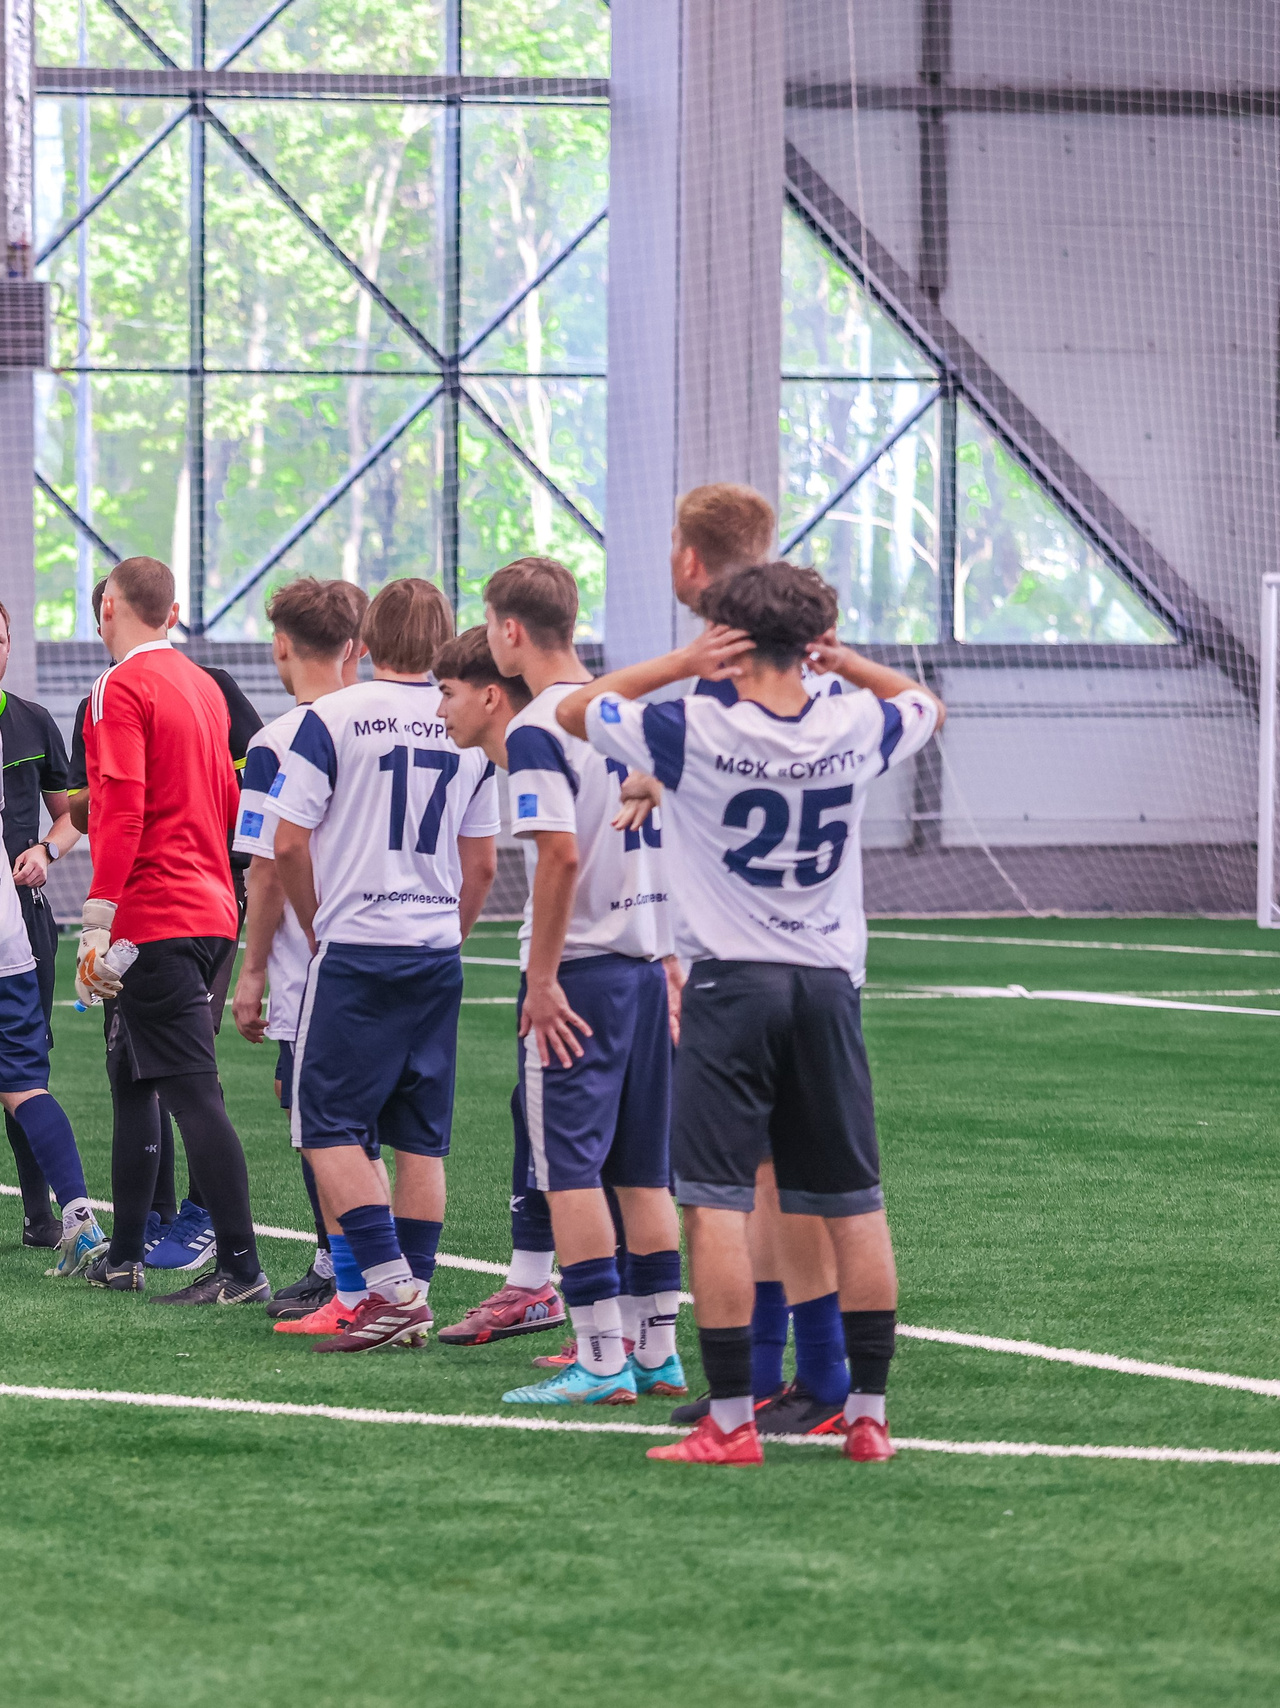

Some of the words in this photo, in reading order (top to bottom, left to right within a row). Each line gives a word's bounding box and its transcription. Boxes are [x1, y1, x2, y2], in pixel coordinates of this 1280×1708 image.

[354, 717, 399, 737] МФК
[715, 754, 769, 779] МФК
[379, 744, 461, 856] 17
[721, 783, 854, 889] 25
